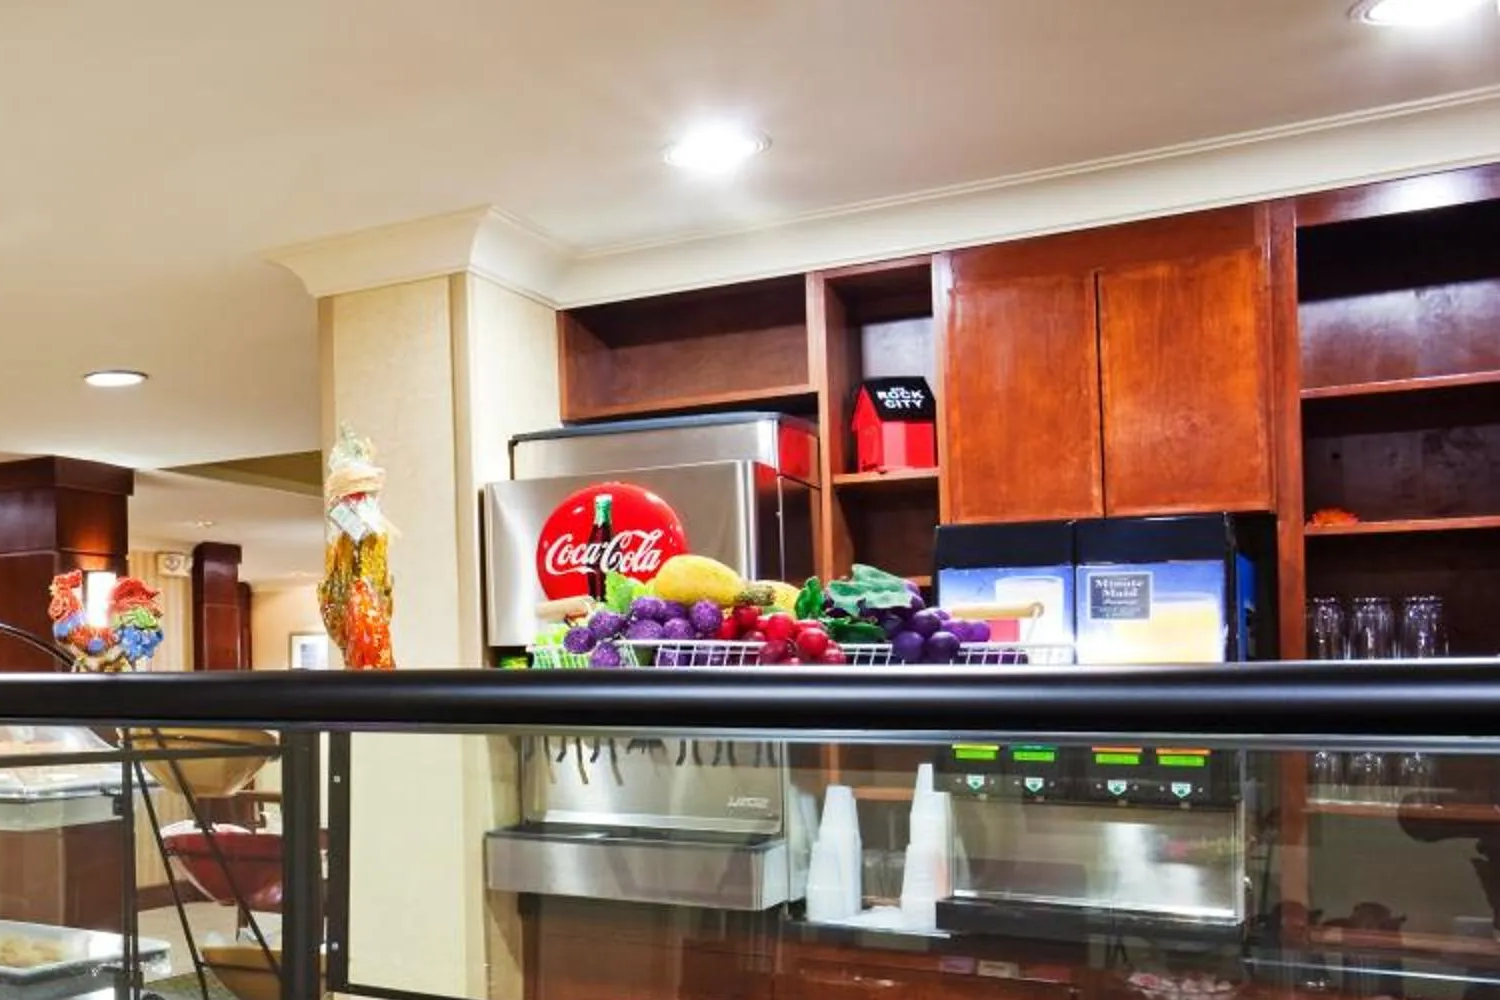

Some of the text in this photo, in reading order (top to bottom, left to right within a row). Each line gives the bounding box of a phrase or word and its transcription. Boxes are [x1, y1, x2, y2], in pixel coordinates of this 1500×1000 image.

[876, 389, 925, 400] ROCK
[884, 400, 922, 409] CITY
[545, 528, 664, 575] Coca-Cola
